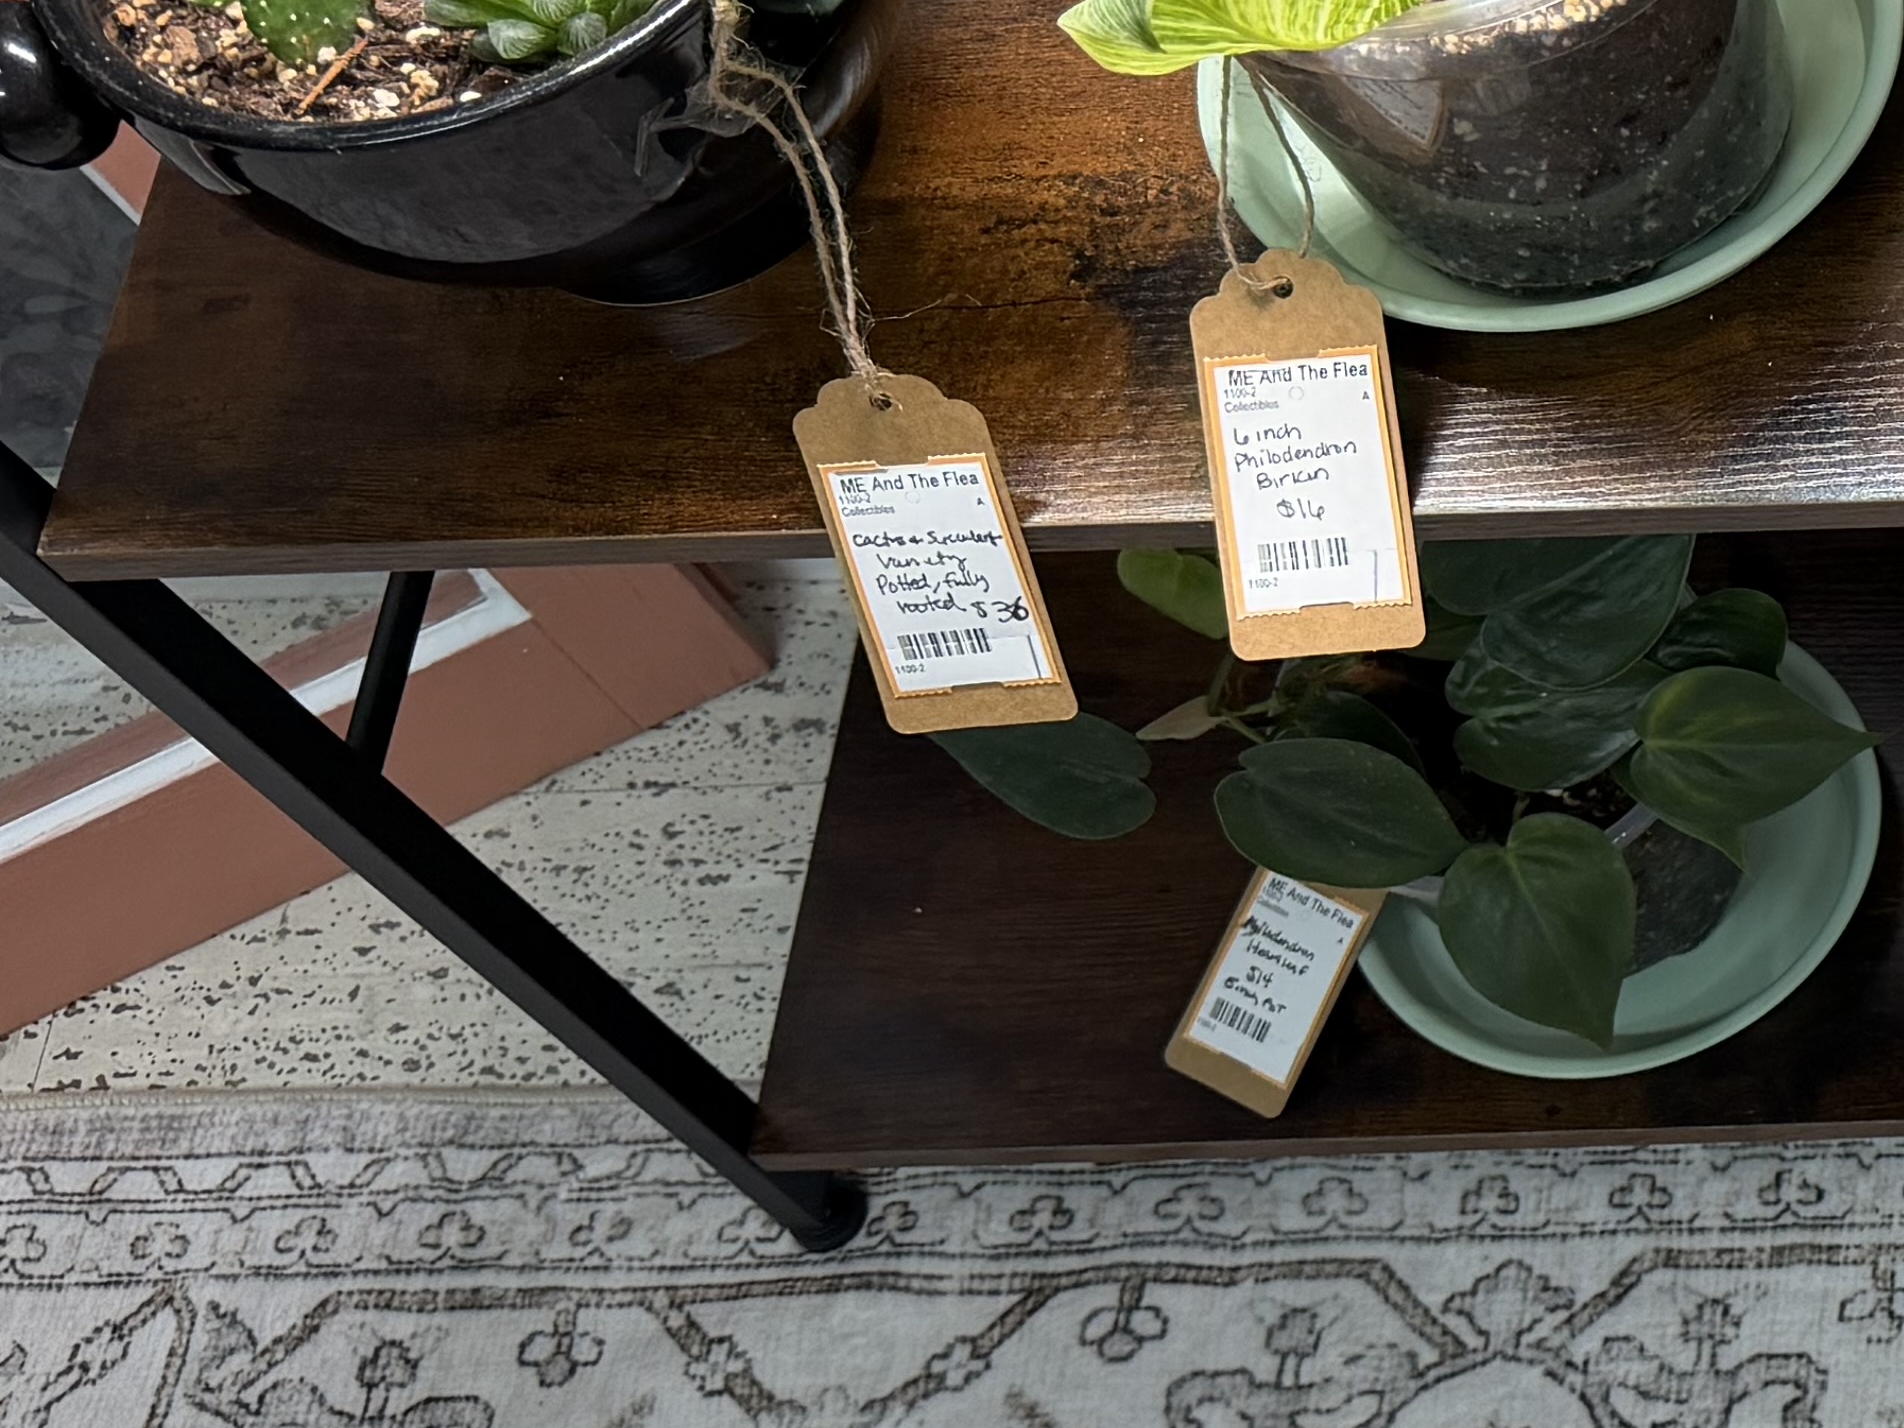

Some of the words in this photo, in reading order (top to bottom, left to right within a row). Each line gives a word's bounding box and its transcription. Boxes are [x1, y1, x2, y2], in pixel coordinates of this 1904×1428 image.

[1228, 369, 1254, 386] ME
[1259, 367, 1292, 384] And
[1298, 364, 1328, 381] The
[1333, 362, 1368, 378] Flea
[1224, 400, 1280, 413] Collectibles
[1233, 427, 1250, 446] 6
[1256, 423, 1302, 442] inch
[1234, 440, 1357, 472] Philodendron
[840, 477, 867, 494] ME
[872, 475, 904, 491] And
[907, 473, 940, 489] The
[942, 471, 979, 486] Flea
[1256, 467, 1330, 490] Birkin
[1276, 497, 1325, 521] $16
[1269, 878, 1288, 891] ME
[1287, 887, 1310, 906] And
[1311, 898, 1331, 916] The
[1330, 908, 1354, 929] Flea
